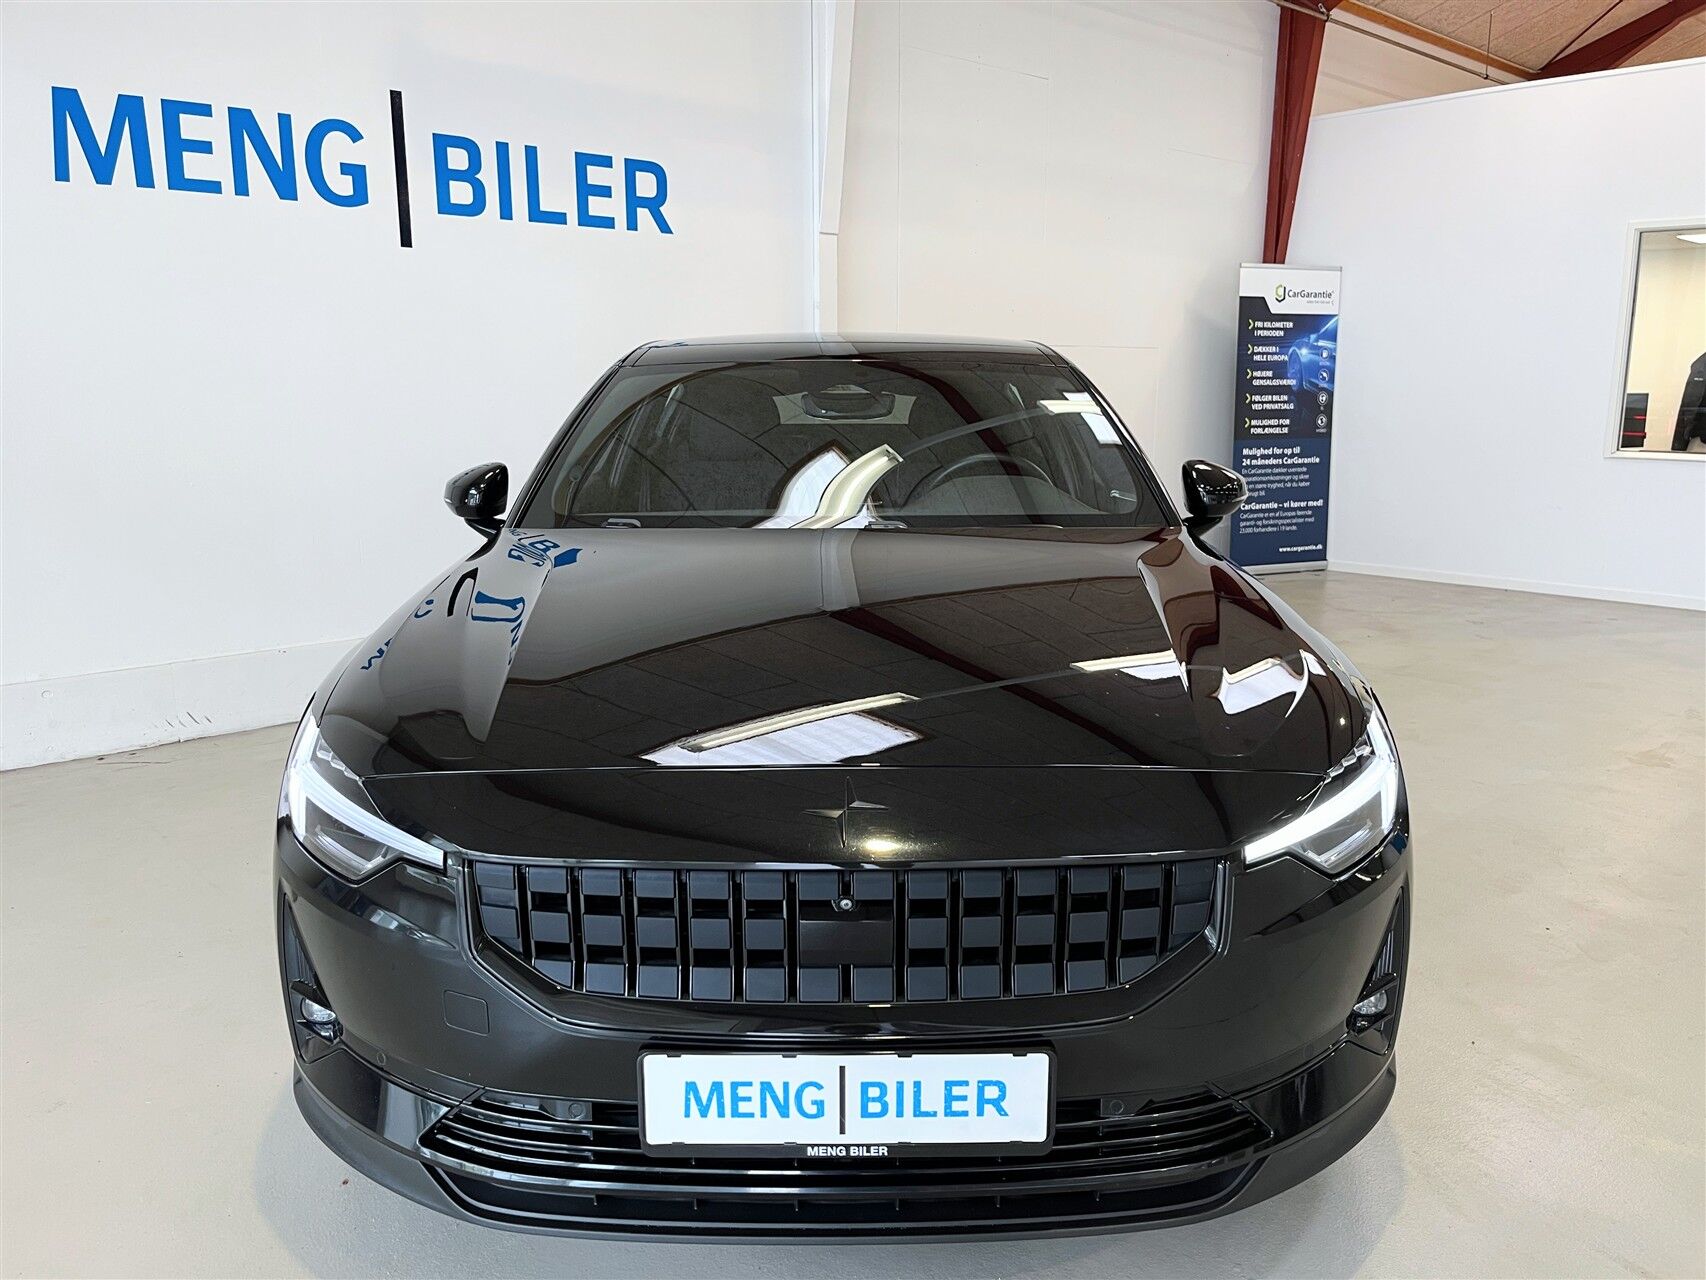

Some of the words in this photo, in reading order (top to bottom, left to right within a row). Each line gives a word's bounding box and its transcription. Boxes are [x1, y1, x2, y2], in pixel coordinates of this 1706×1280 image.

[51, 86, 369, 207] MENG
[432, 132, 674, 235] BILER
[1287, 289, 1332, 299] CarGarantie
[1264, 321, 1293, 329] KILOMETER
[1242, 447, 1273, 456] Mulighed
[1241, 458, 1250, 466] 24
[1251, 457, 1282, 466] måneders
[1283, 456, 1320, 465] CarGarantie
[1240, 502, 1278, 510] CarGarantie
[1307, 499, 1324, 507] med!
[684, 1081, 825, 1119] MENG
[860, 1080, 1010, 1118] BILER
[807, 1146, 846, 1157] MENG
[850, 1146, 889, 1157] BILER
